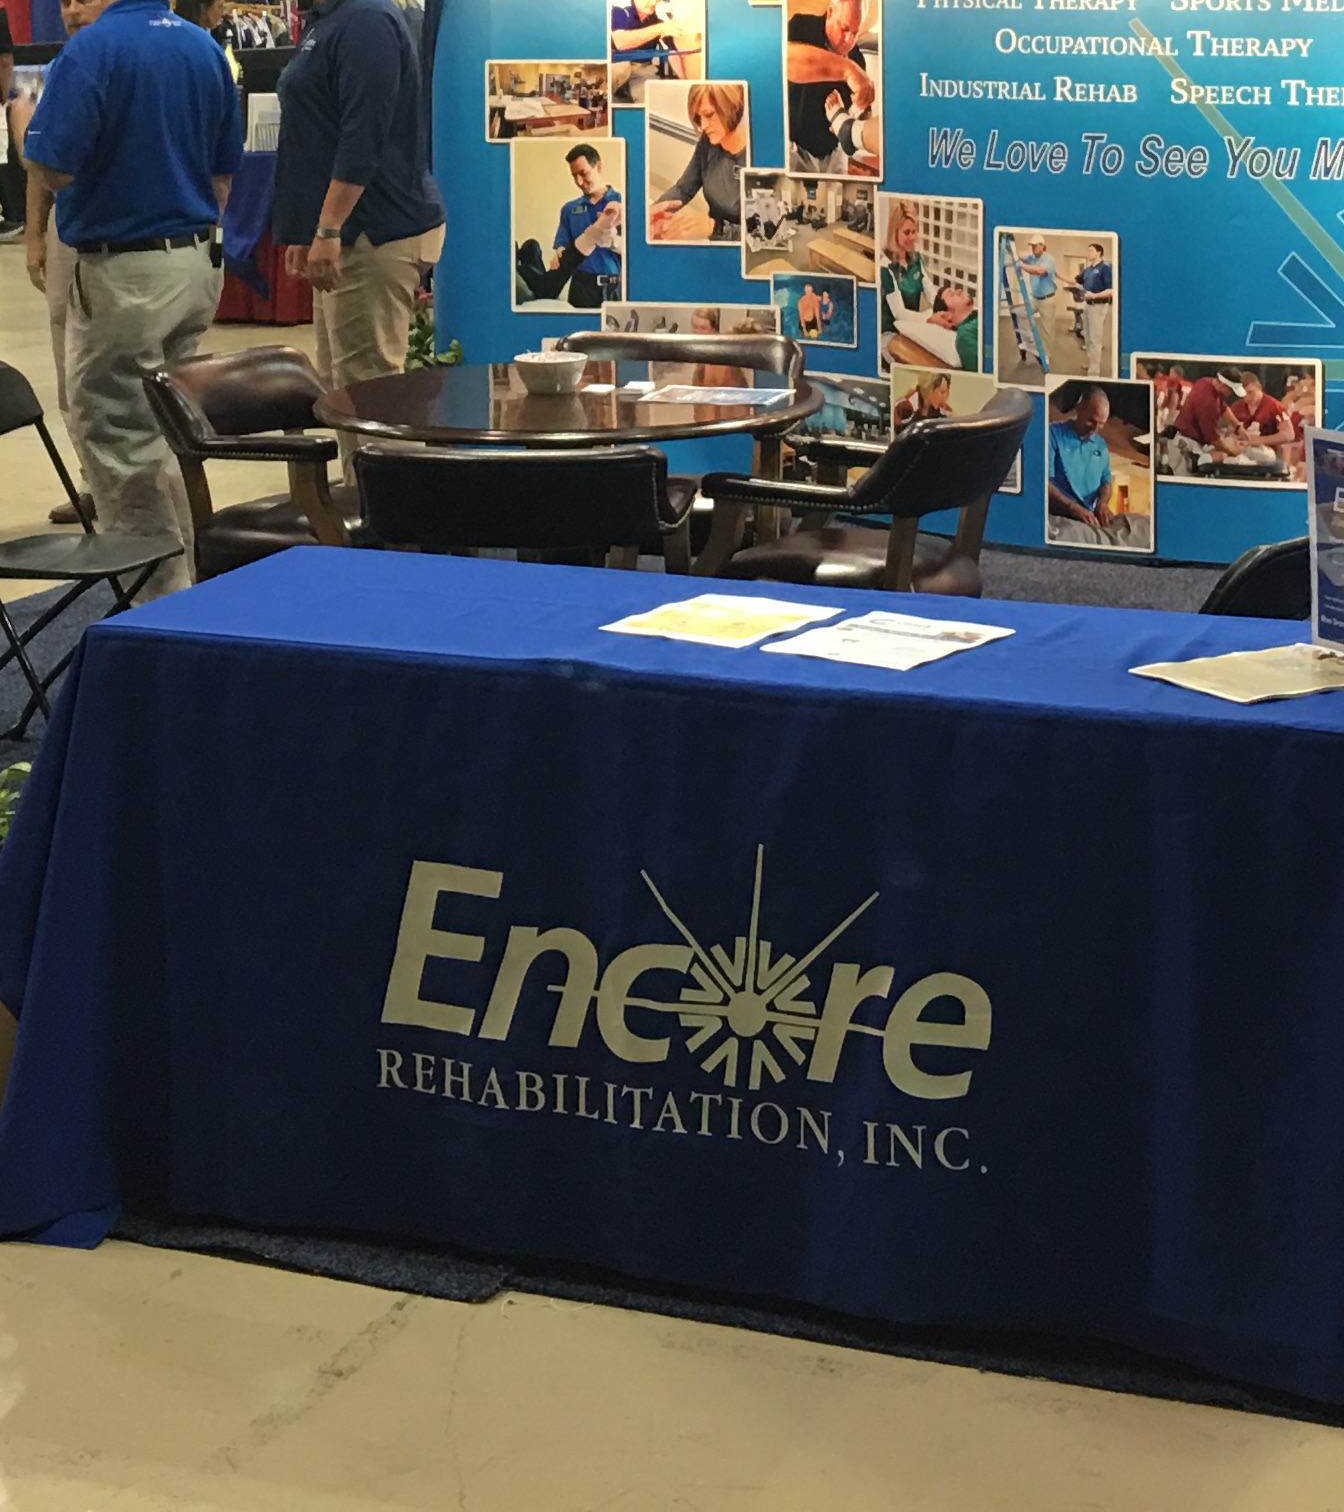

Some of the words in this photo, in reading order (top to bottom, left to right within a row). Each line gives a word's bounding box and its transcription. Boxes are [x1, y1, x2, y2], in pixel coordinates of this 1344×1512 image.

[927, 126, 977, 172] We
[984, 129, 1068, 174] Love
[1081, 133, 1125, 176] To
[1135, 133, 1209, 179] See
[1225, 136, 1301, 181] You
[376, 1048, 845, 1166] REHABILITATION,
[861, 1120, 989, 1175] INC.
